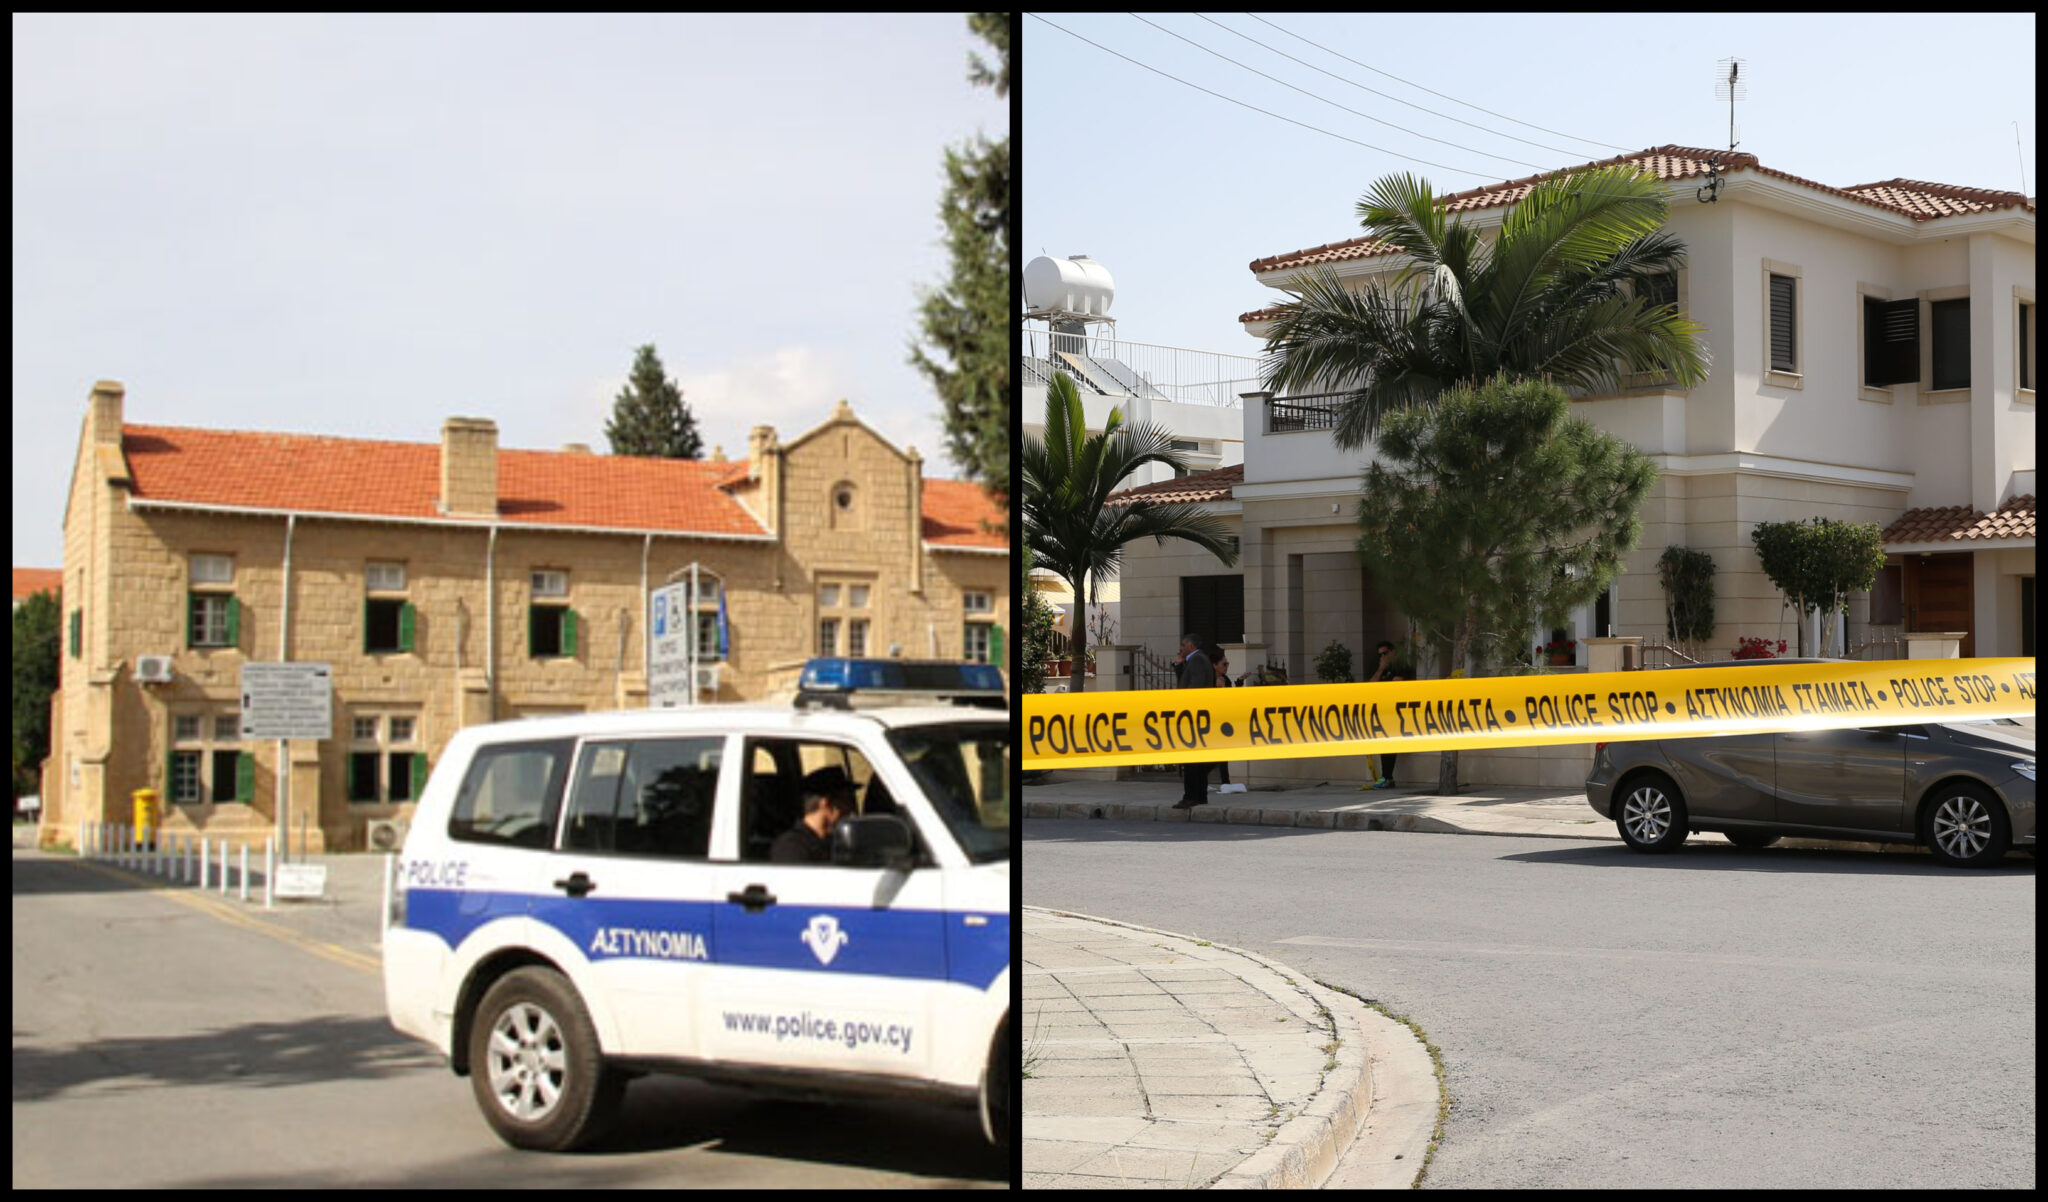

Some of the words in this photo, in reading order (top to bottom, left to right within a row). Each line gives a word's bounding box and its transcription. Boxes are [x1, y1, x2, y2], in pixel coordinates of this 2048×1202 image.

[1028, 712, 1134, 756] POLICE
[1143, 709, 1211, 751] STOP
[1248, 702, 1389, 745] ΑΣΤΥΝΟΜΙΑ
[1394, 697, 1502, 737] ΣΤΑΜΑΤΑ
[1524, 692, 1602, 730] POLICE
[1607, 690, 1660, 725] STOP
[1685, 684, 1790, 720] ΑΣΤΥΝΟΜΙΑ
[1791, 680, 1877, 713] ΣΤΑΜΑΤΑ
[1889, 676, 1956, 708] POLICE
[1953, 674, 1997, 704] STOP
[408, 860, 466, 887] POLICE
[591, 928, 707, 960] ΑΣΤΥΝΟΜΙΑ
[723, 1011, 912, 1054] www.police.gov.cy
